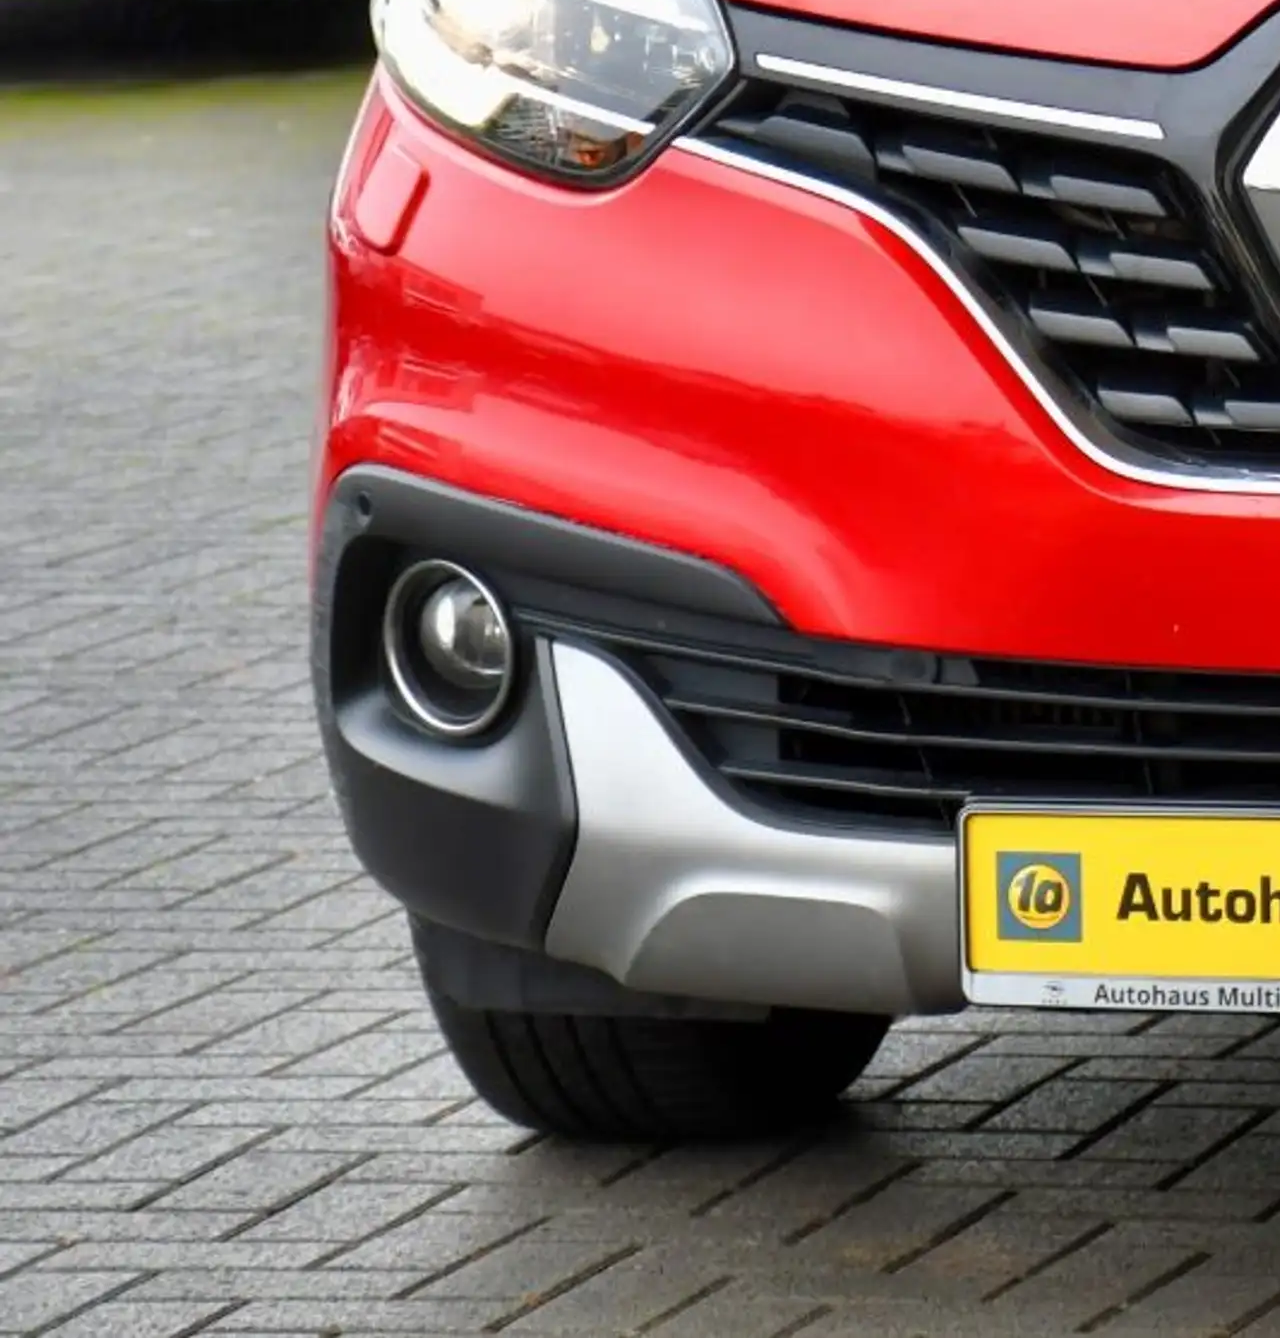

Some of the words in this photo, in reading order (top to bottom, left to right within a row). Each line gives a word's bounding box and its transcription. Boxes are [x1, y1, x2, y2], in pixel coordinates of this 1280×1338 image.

[1014, 869, 1064, 914] 1a
[1094, 984, 1209, 1006] Autohaus
[1218, 986, 1280, 1008] Multi
